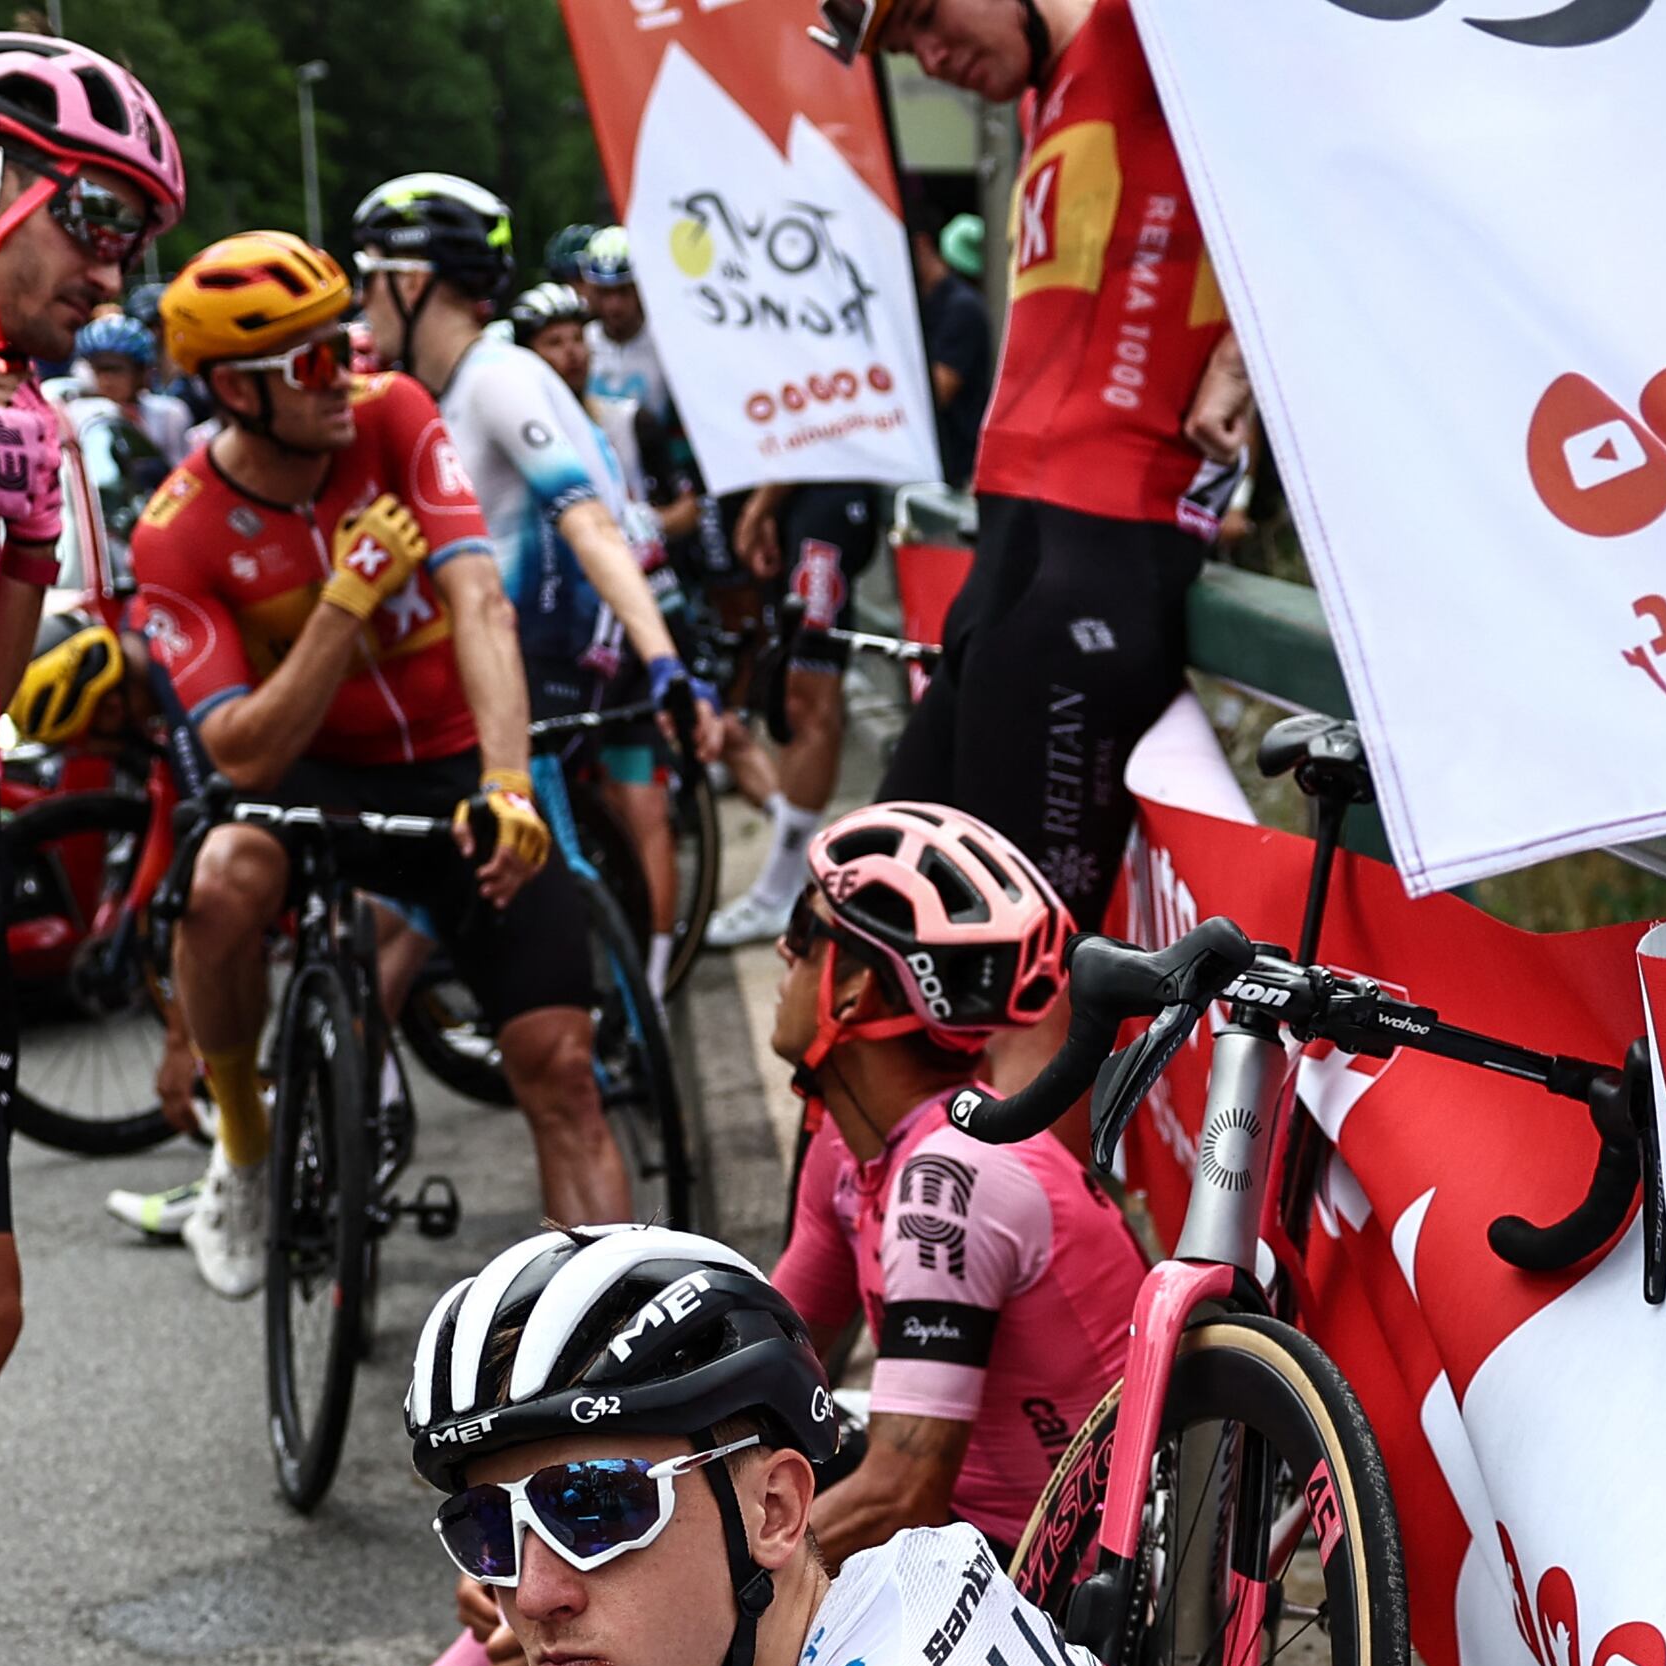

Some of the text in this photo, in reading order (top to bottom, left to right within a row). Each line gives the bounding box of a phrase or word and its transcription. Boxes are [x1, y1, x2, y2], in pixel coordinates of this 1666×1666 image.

[1102, 194, 1177, 409] REMA 1000
[1043, 683, 1085, 837] REITAN
[906, 951, 952, 1019] POC
[1224, 974, 1291, 1007] ion
[1378, 1012, 1430, 1035] wahoo
[609, 1269, 712, 1363] MET
[430, 1412, 499, 1448] MET
[571, 1396, 621, 1424] G42
